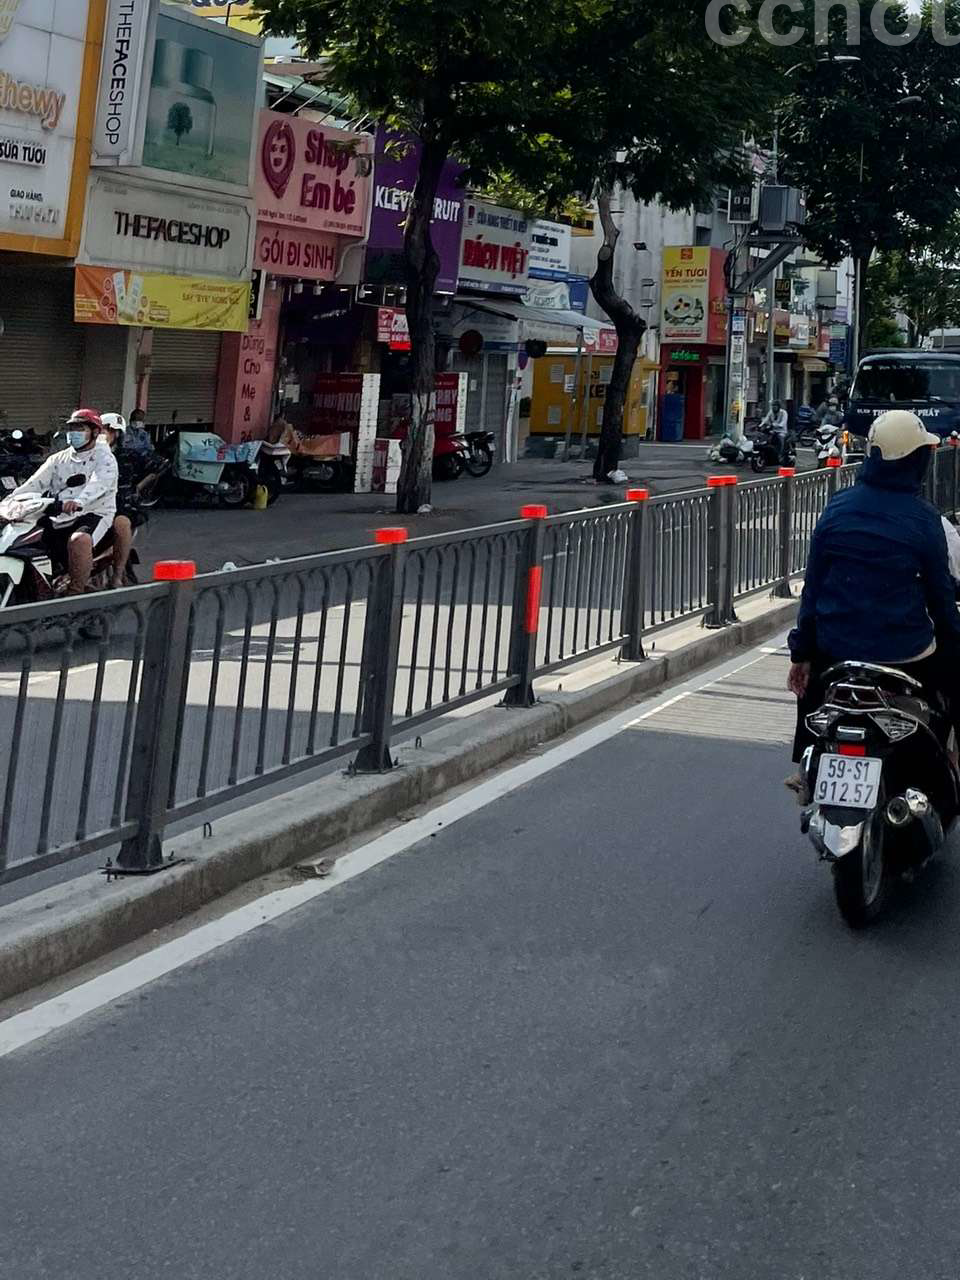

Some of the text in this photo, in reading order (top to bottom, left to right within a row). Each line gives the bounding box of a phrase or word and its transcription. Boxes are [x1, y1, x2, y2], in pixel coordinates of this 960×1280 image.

[105, 0, 134, 145] THEFACESHOP
[0, 72, 65, 129] hewy
[304, 128, 350, 177] Shop
[333, 179, 356, 215] bé
[375, 185, 460, 222] KLEV RUIT
[114, 210, 230, 249] THEFACESHOP
[260, 229, 284, 265] GÓI
[303, 242, 335, 270] SINH
[827, 759, 870, 782] 59-S1
[818, 781, 874, 805] 912.57
